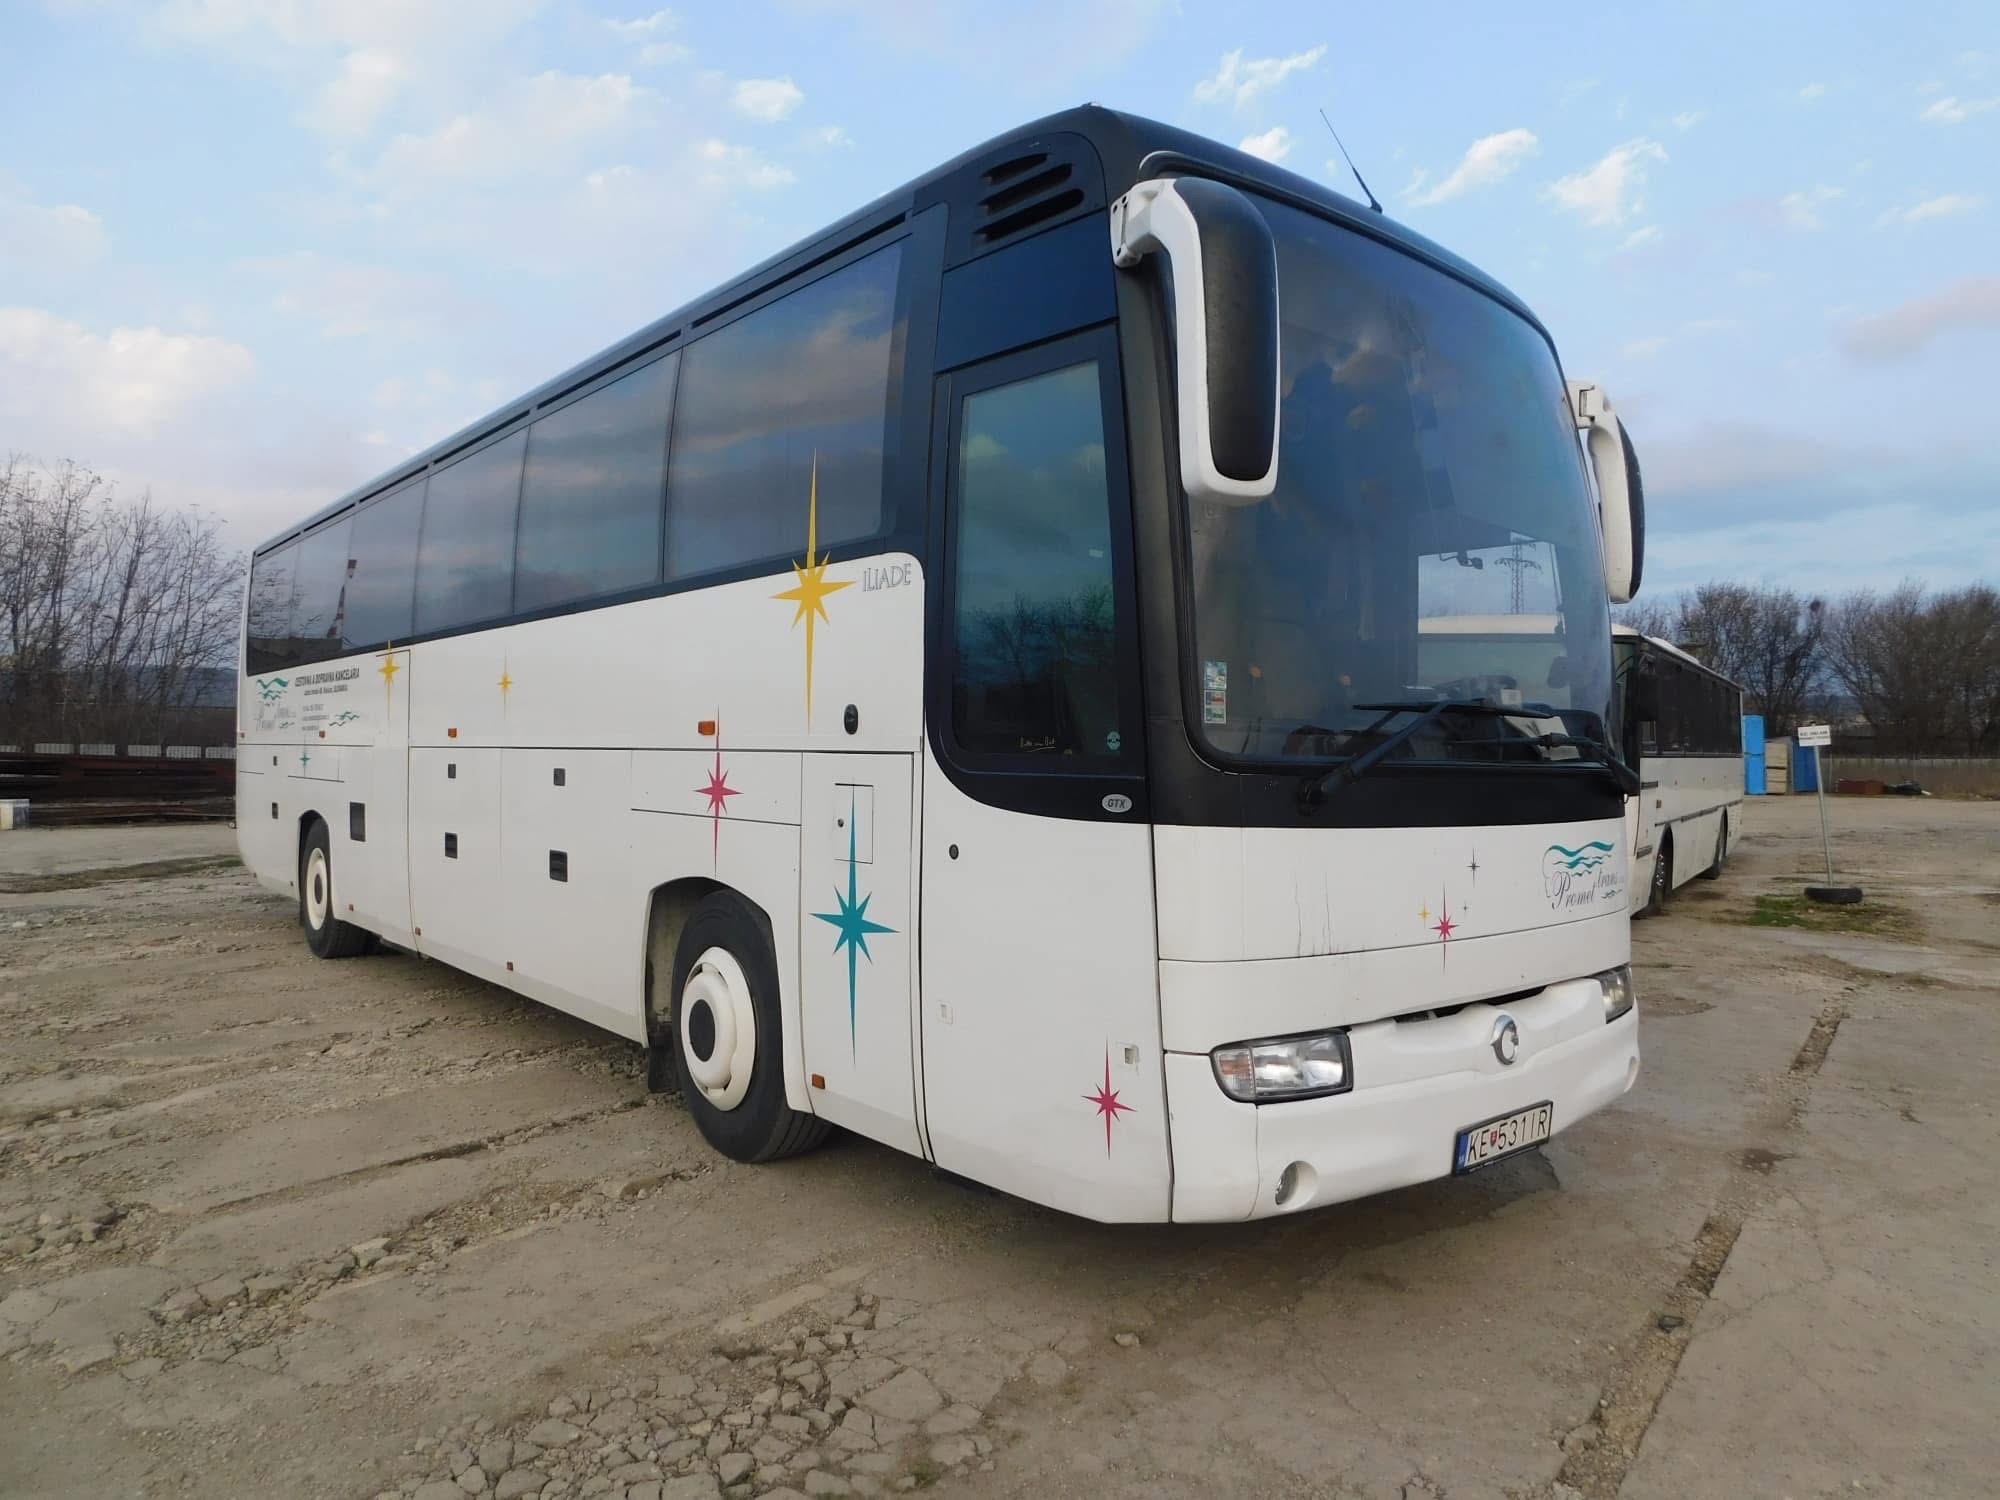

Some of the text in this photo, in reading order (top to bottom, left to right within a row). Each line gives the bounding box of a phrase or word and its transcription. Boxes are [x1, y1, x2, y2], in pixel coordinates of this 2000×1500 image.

[863, 563, 912, 592] ILIADE
[1107, 798, 1126, 809] GTX
[1468, 1109, 1547, 1160] KE 531IR
